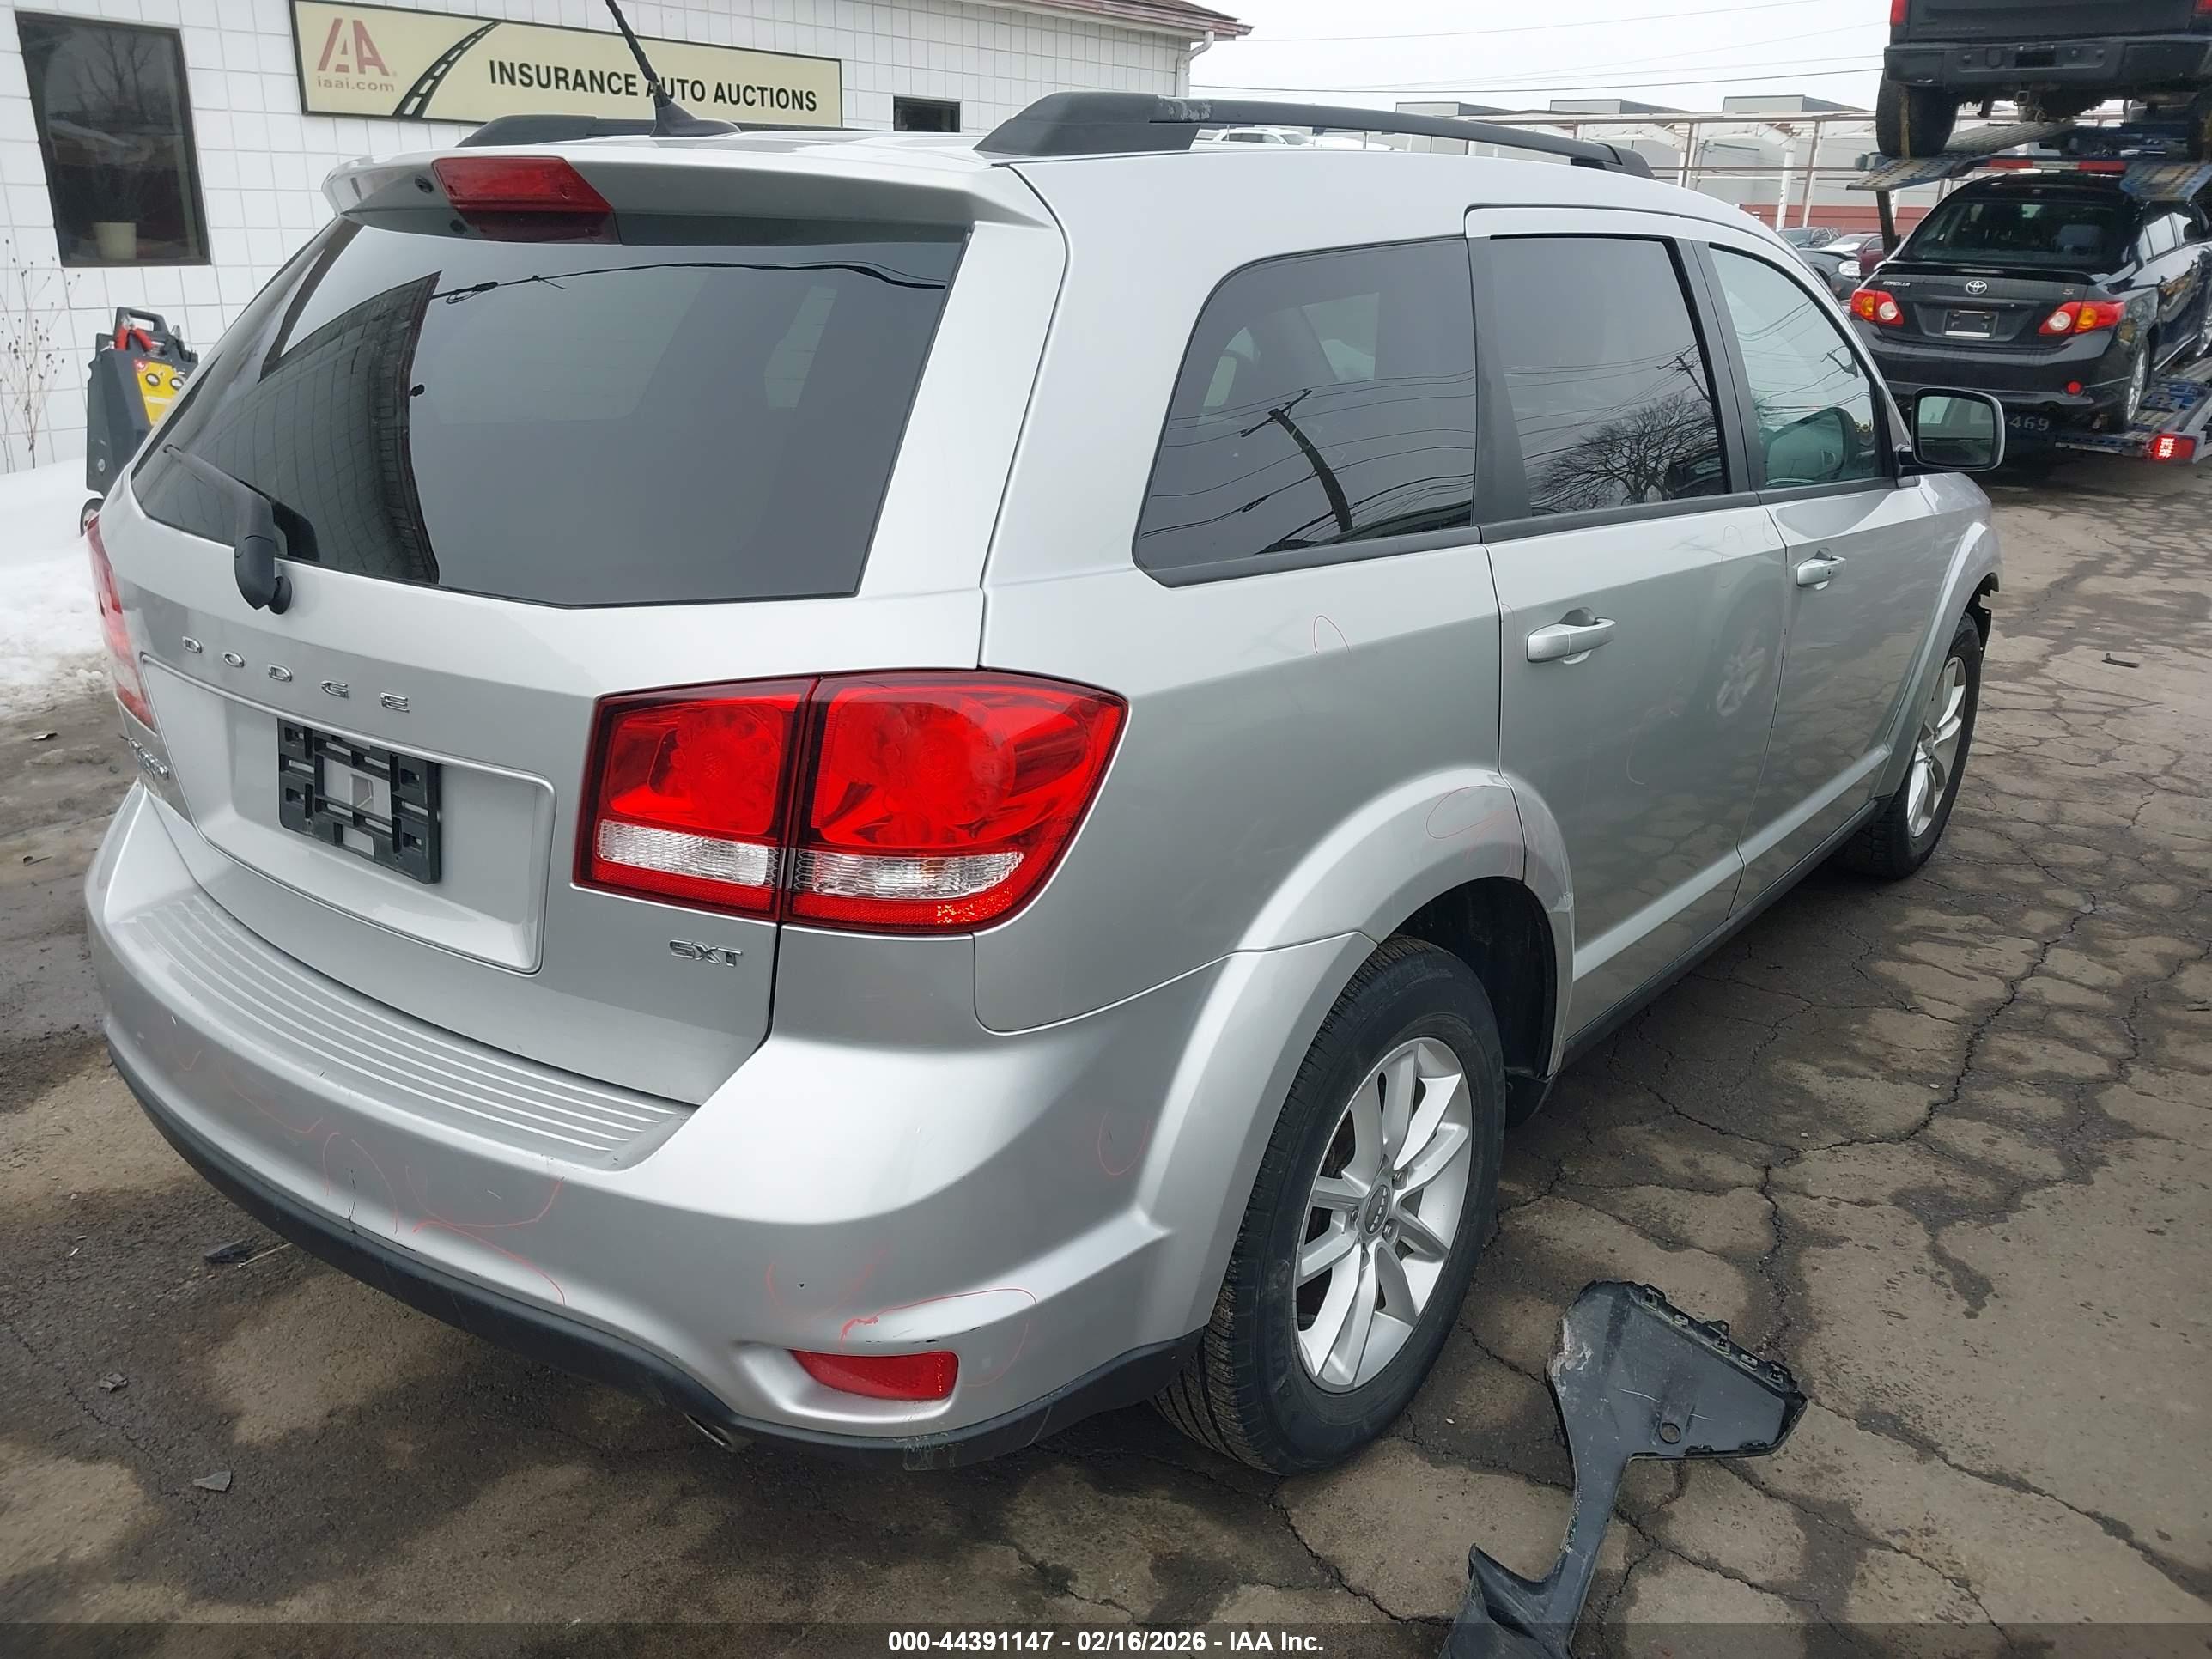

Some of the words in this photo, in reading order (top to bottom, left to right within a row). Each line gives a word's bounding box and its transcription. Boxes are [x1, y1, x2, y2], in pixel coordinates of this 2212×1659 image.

[317, 76, 394, 92] iaai.com
[489, 60, 638, 96] INSURANCE
[713, 82, 817, 112] AUCTIONS
[2005, 416, 2050, 431] 469
[182, 635, 410, 714] DODGE
[669, 939, 743, 967] SXT
